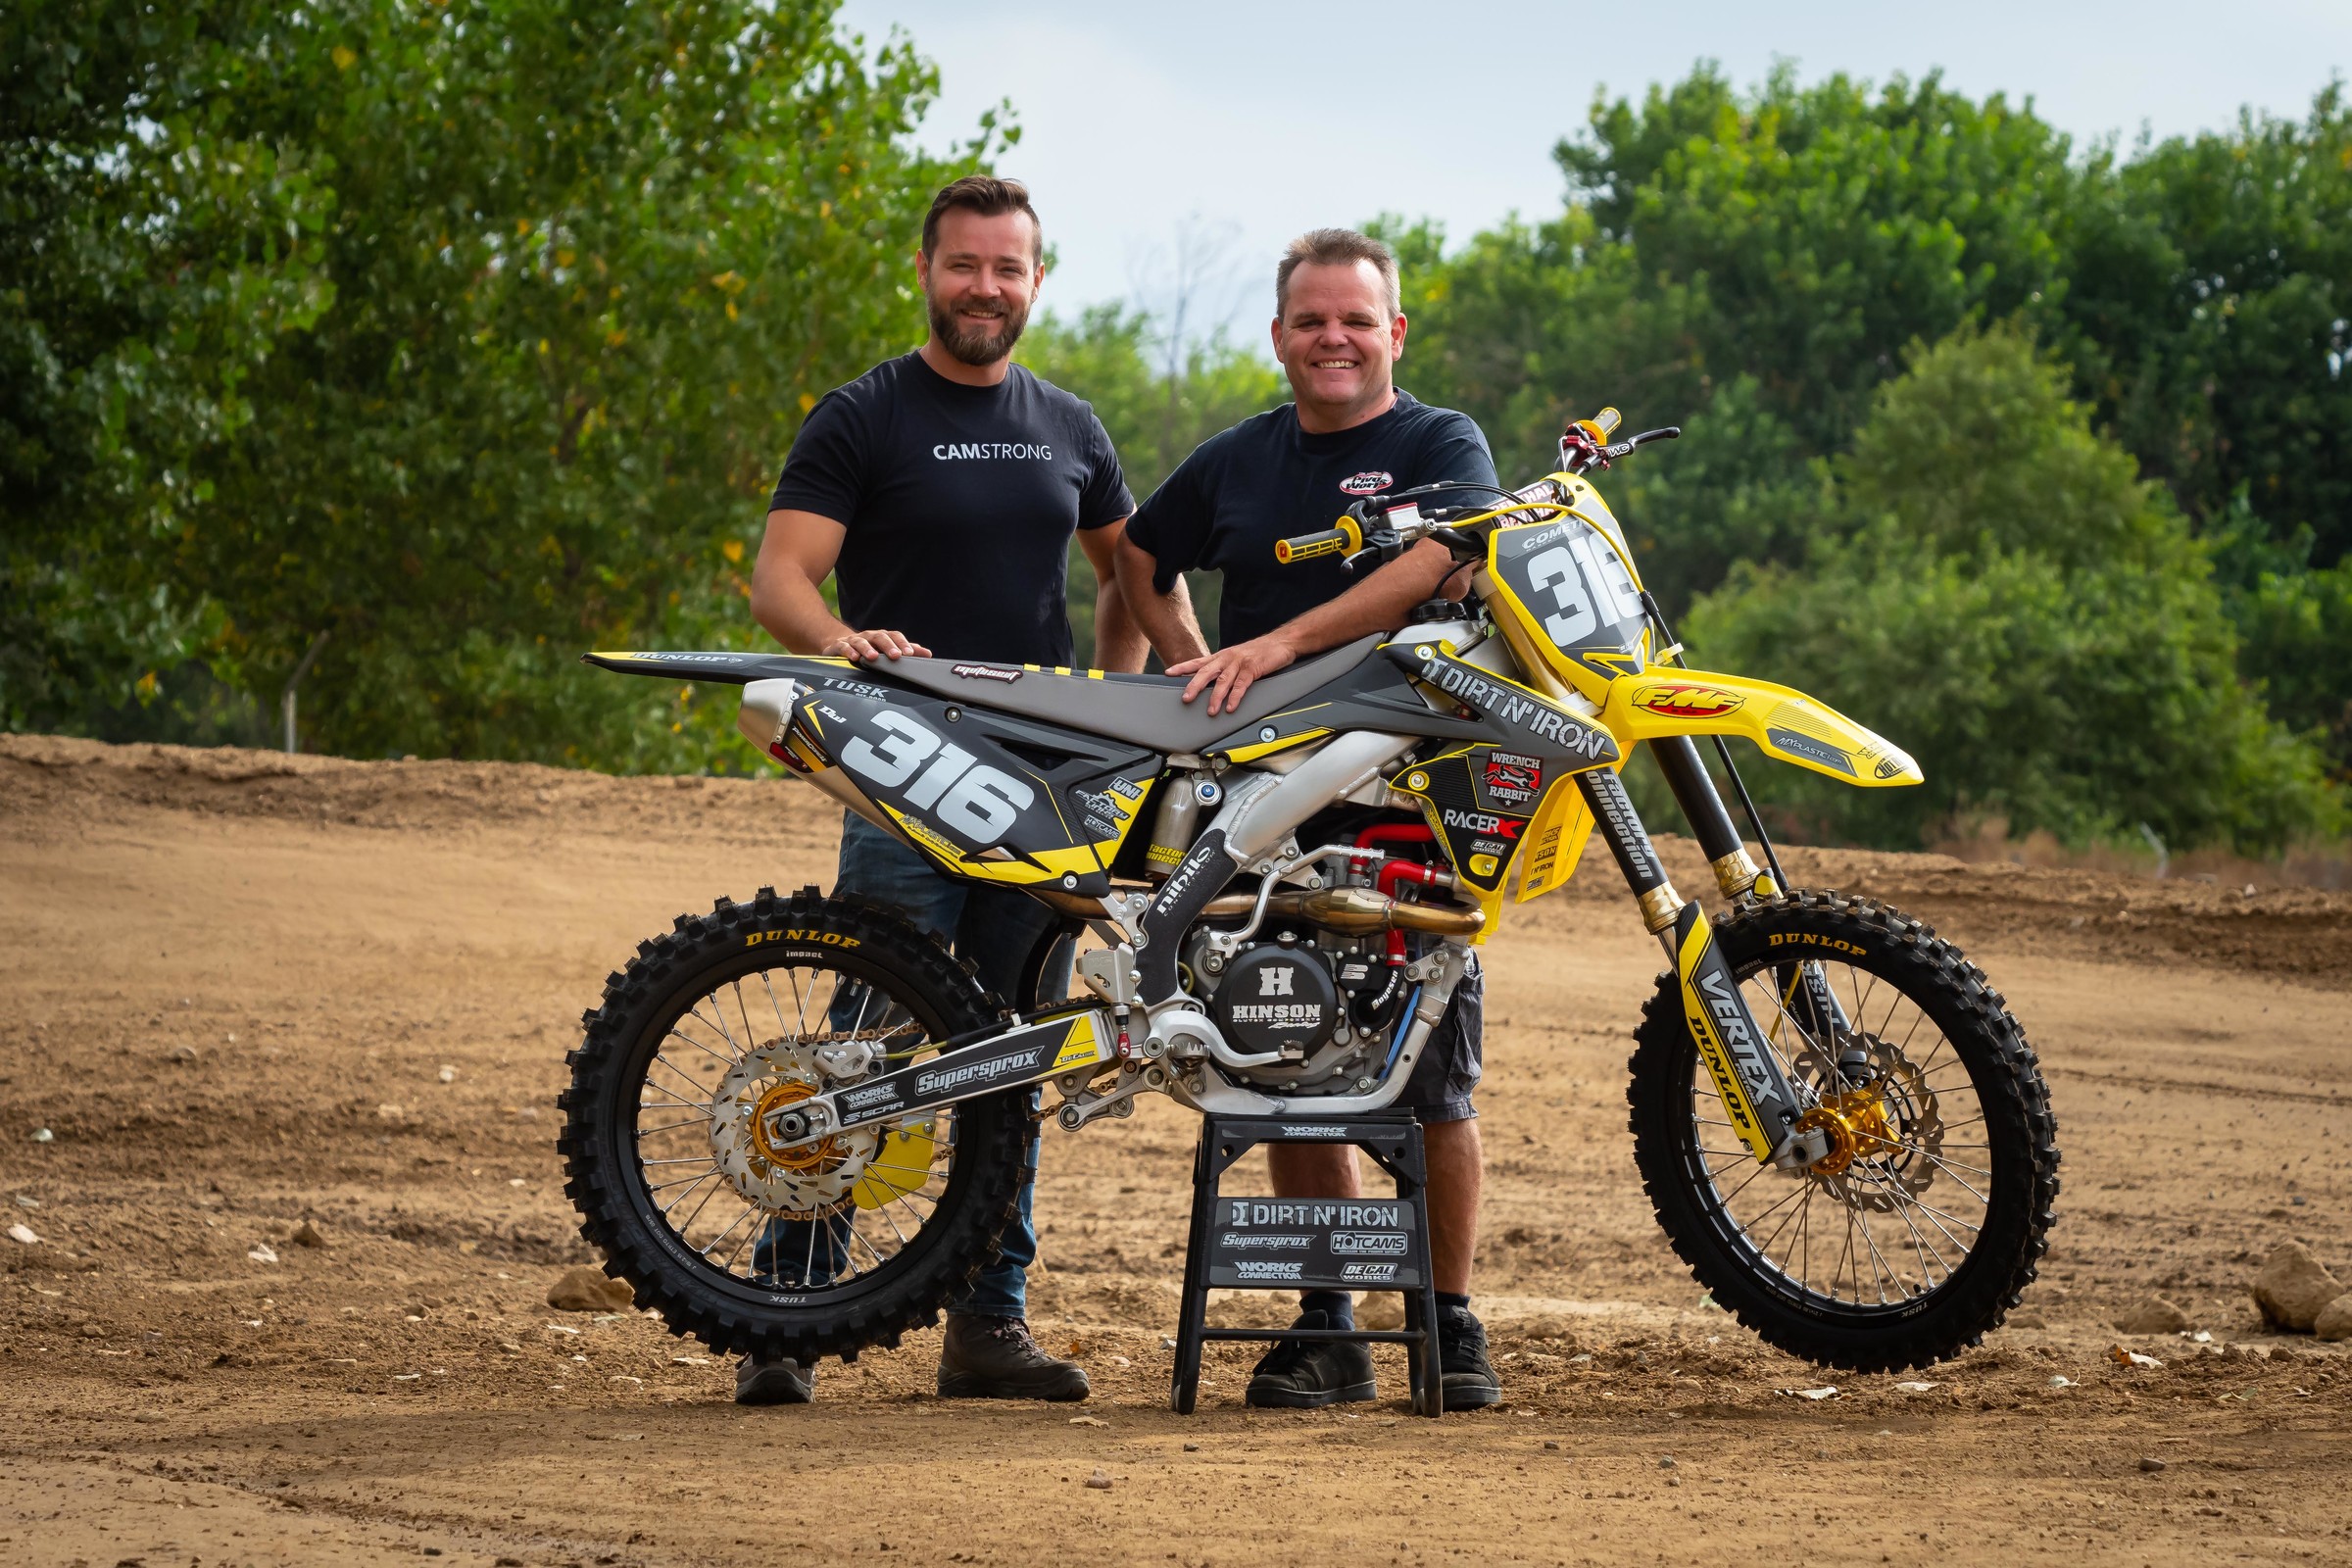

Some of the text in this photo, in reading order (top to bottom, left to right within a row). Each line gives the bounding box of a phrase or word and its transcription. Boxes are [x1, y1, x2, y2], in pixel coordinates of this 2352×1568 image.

[932, 443, 1053, 461] CAMSTRONG
[631, 653, 728, 662] DUNLOP
[823, 677, 890, 698] TUSK
[1441, 667, 1507, 710] DIRT
[1632, 688, 1747, 710] FMF
[1491, 752, 1541, 770] WRENCH
[840, 710, 1035, 844] 316
[1112, 779, 1141, 799] UNI
[1488, 786, 1532, 803] RABBIT
[1585, 770, 1654, 879] onnection
[1149, 844, 1186, 859] Factor
[1157, 846, 1211, 914] nihilo
[745, 929, 861, 948] DUNLOP
[1769, 933, 1867, 956] DUNLOP
[785, 950, 823, 958] impact
[1232, 1004, 1321, 1019] HINSON
[1700, 969, 1782, 1103] VERTEX
[917, 1049, 1039, 1093] Supersprox
[1690, 1015, 1751, 1129] DUNLOP
[844, 1083, 894, 1102] WORKS
[849, 1093, 896, 1108] CONNECTION
[1253, 1204, 1309, 1225] DIRT
[1221, 1234, 1311, 1250] Supersprox
[1333, 1236, 1405, 1250] HOTCAMS
[1235, 1261, 1304, 1273] WORKS
[1238, 1271, 1302, 1280] CONNECTION
[1345, 1264, 1395, 1275] DECAL
[769, 1295, 808, 1303] TUSK
